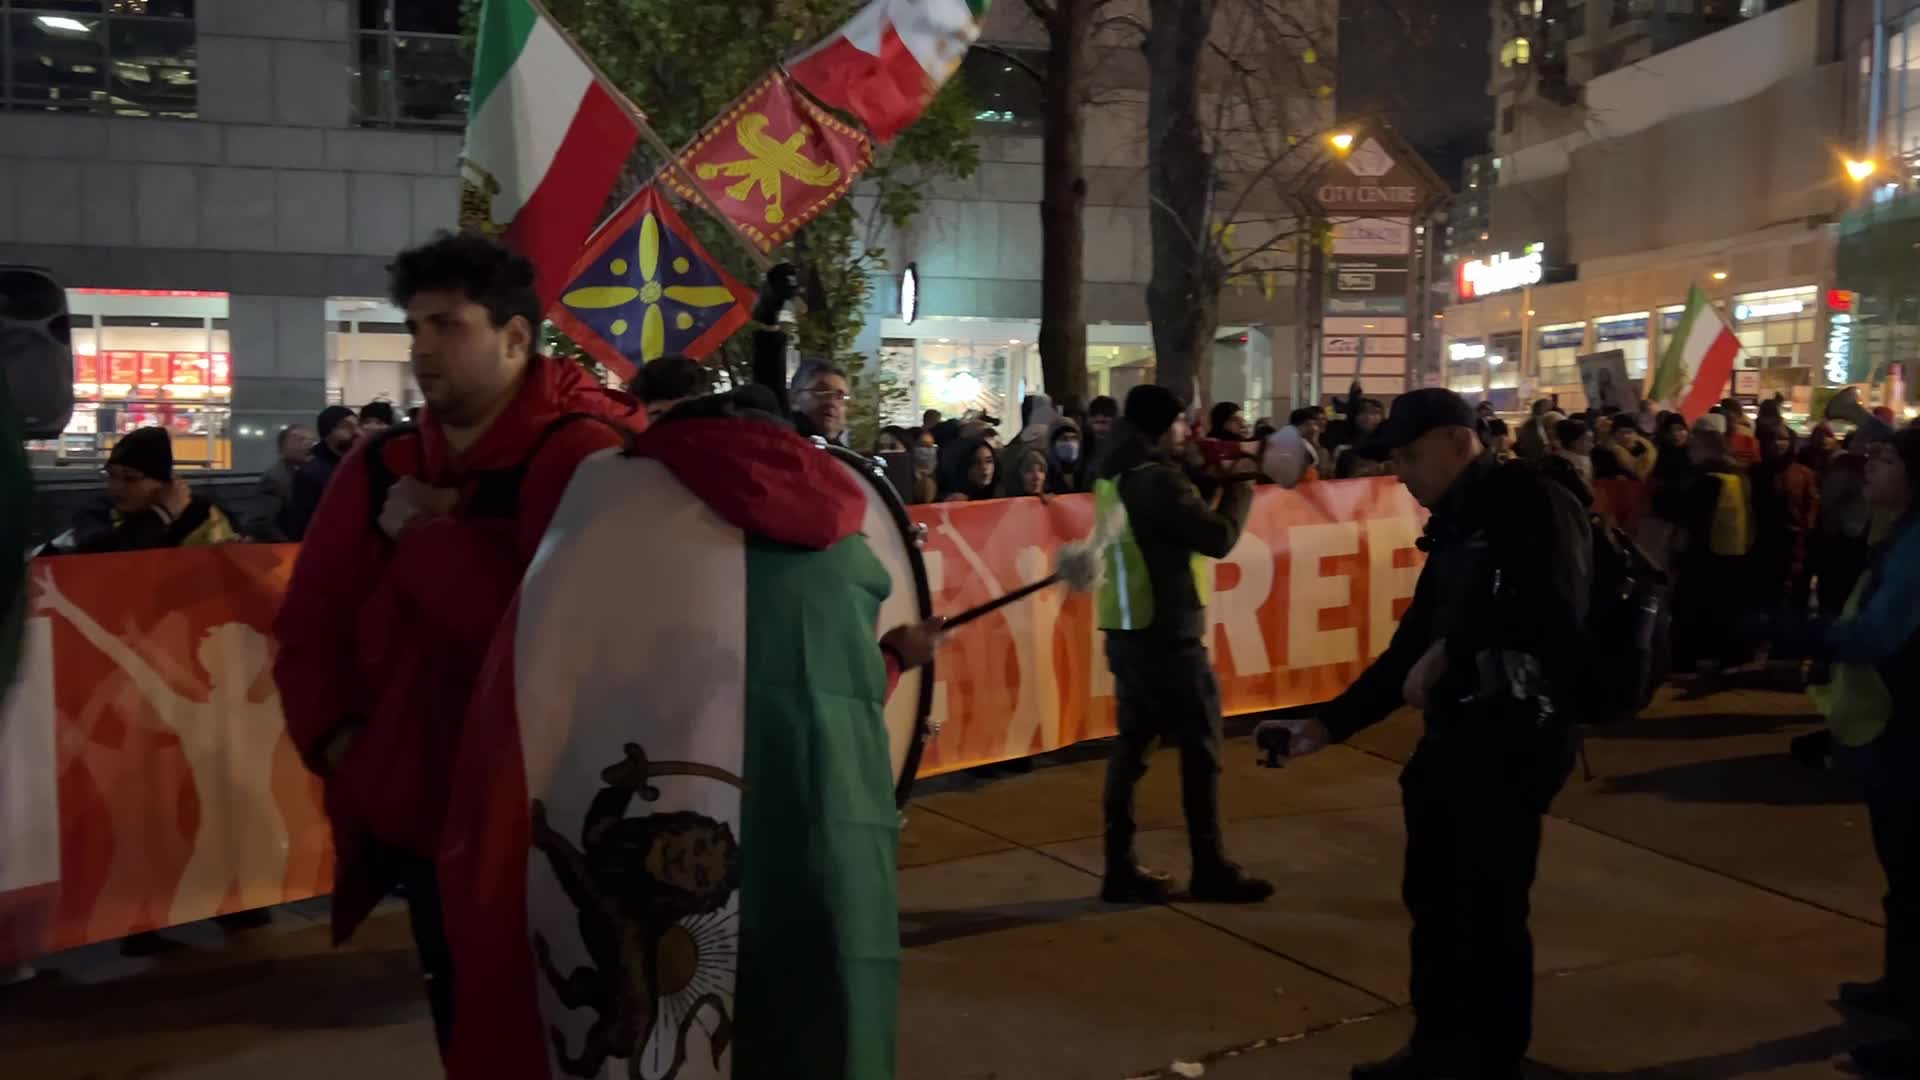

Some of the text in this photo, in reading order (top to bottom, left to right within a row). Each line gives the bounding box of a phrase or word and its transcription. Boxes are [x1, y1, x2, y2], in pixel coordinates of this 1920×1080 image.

[1319, 186, 1416, 202] CITY CENTRE
[1824, 313, 1850, 384] oblaws
[1091, 516, 1422, 697] REE
